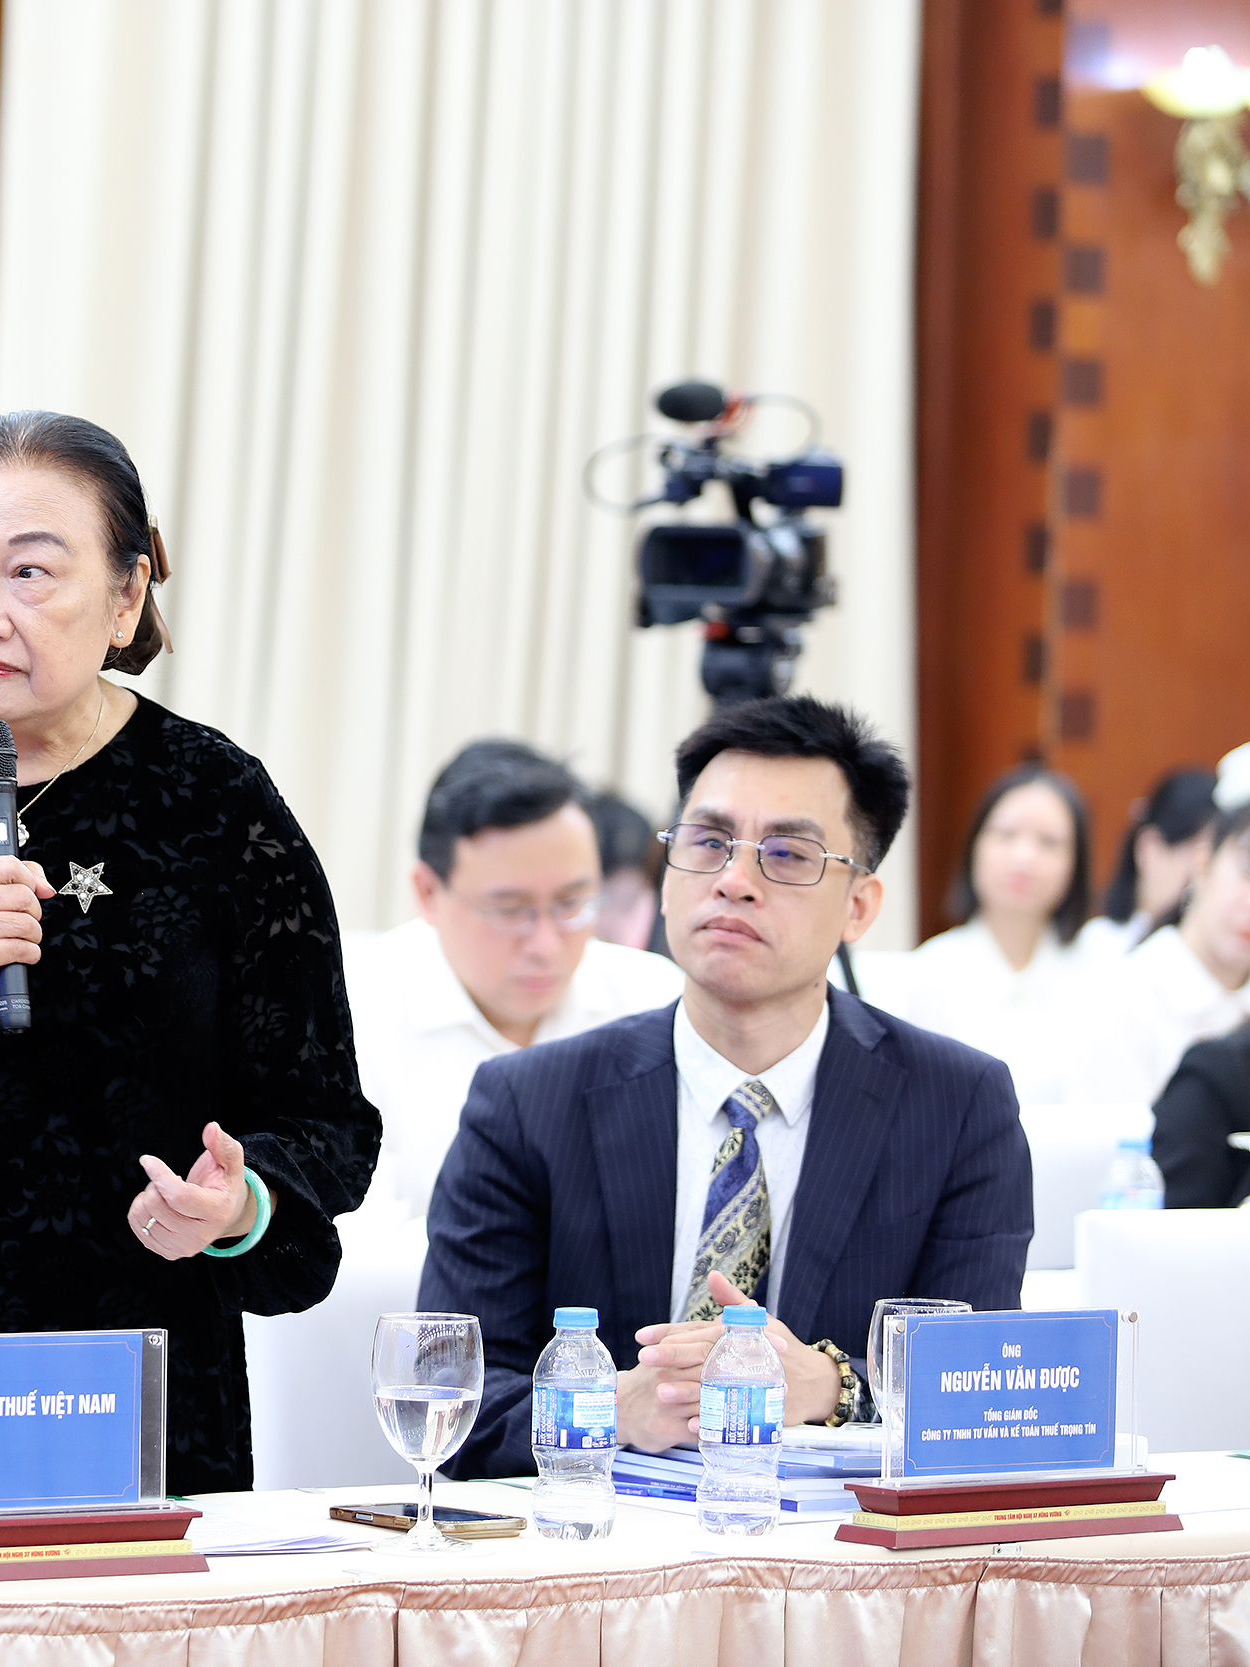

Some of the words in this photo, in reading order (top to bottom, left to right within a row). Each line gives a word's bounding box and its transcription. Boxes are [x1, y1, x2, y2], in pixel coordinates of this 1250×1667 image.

[1001, 1342, 1022, 1358] ÔNG
[940, 1362, 1002, 1393] NGUYỄN
[1005, 1364, 1037, 1390] VĂN
[1039, 1365, 1080, 1393] ĐƯỢC
[40, 1390, 75, 1419] VIỆT
[78, 1393, 116, 1414] NAM
[1003, 1407, 1023, 1421] GIÁM
[1023, 1405, 1039, 1420] ĐỐC
[921, 1427, 942, 1441] CÔNG
[942, 1429, 952, 1440] TY
[952, 1428, 972, 1440] TNHH
[972, 1427, 984, 1439] TƯ
[983, 1424, 999, 1439] VẤN
[999, 1424, 1010, 1438] VÀ
[1010, 1423, 1021, 1438] KẾ
[1021, 1423, 1040, 1437] TOÁN
[1040, 1421, 1060, 1437] THUẾ
[1059, 1423, 1084, 1438] TRỌNG
[1084, 1421, 1097, 1435] TÍN
